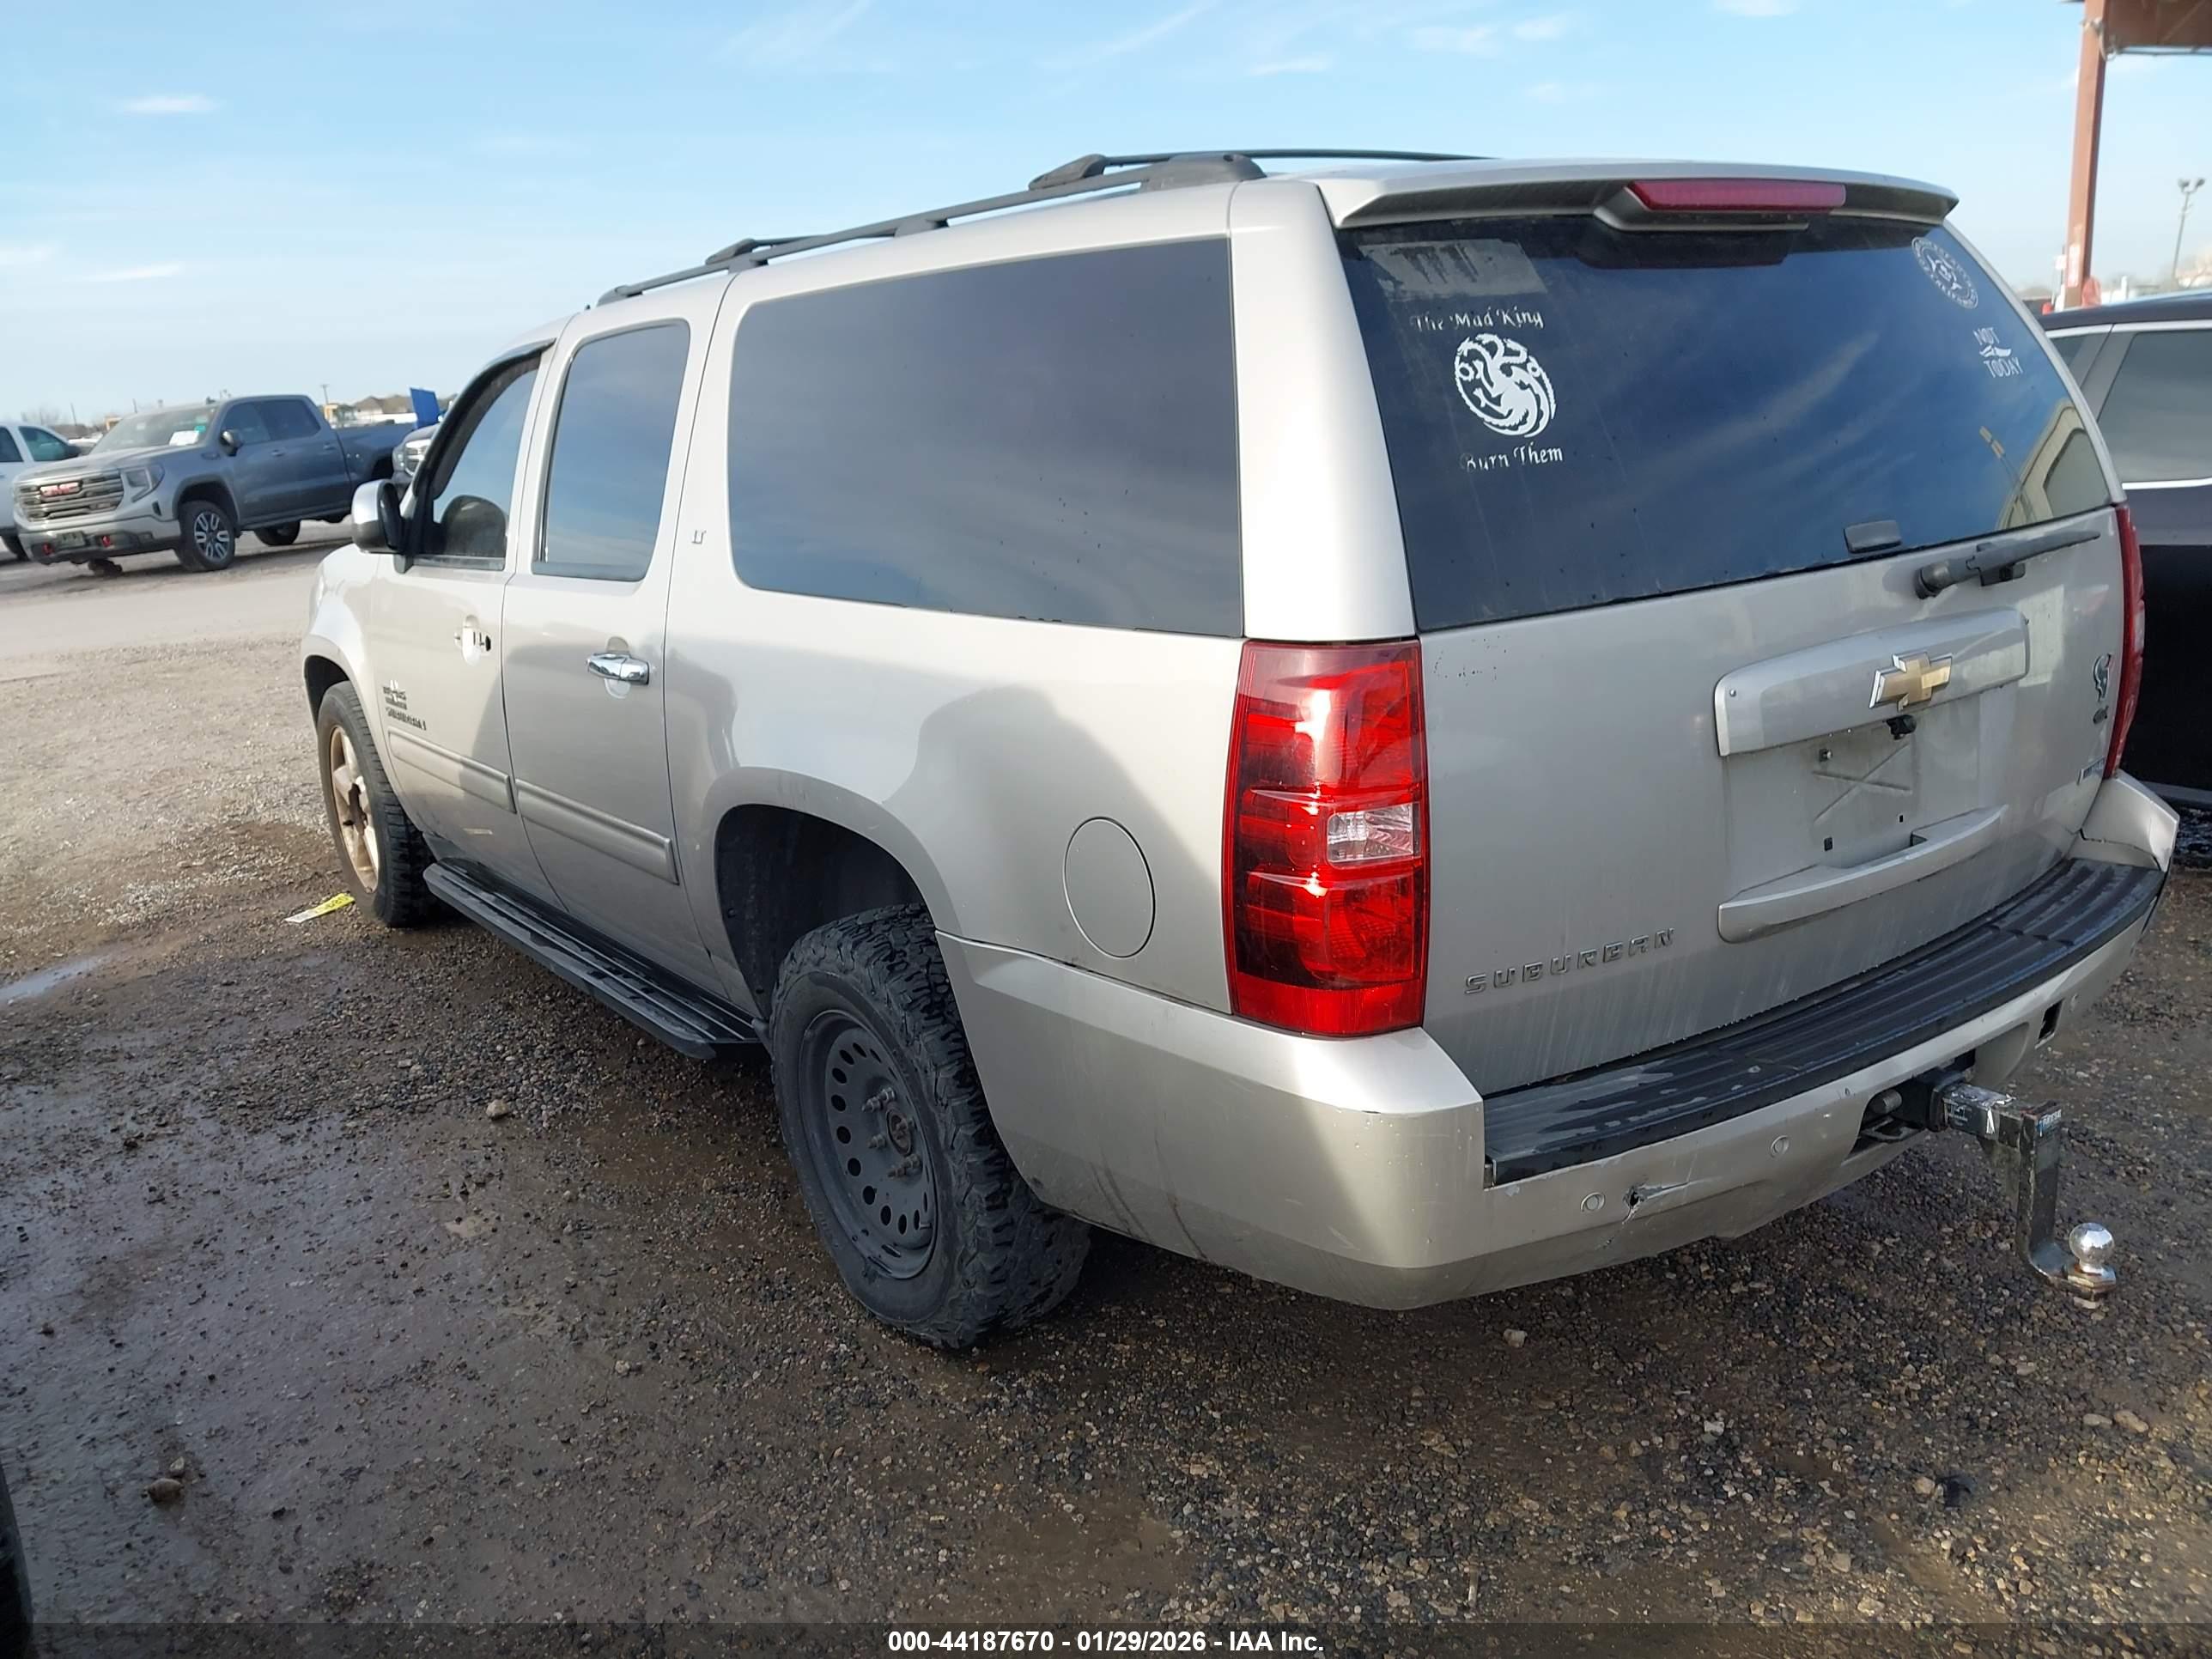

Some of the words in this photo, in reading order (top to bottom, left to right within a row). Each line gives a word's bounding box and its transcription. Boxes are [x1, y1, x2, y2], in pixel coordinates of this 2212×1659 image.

[1411, 312, 1443, 332] The
[1449, 307, 1494, 329] Mad
[1497, 305, 1545, 329] King
[1973, 326, 2000, 345] NOT
[1984, 356, 2024, 378] TODAY
[1513, 441, 1564, 465] Them
[691, 529, 707, 544] LT
[1463, 927, 1675, 995] SUBURBAN
